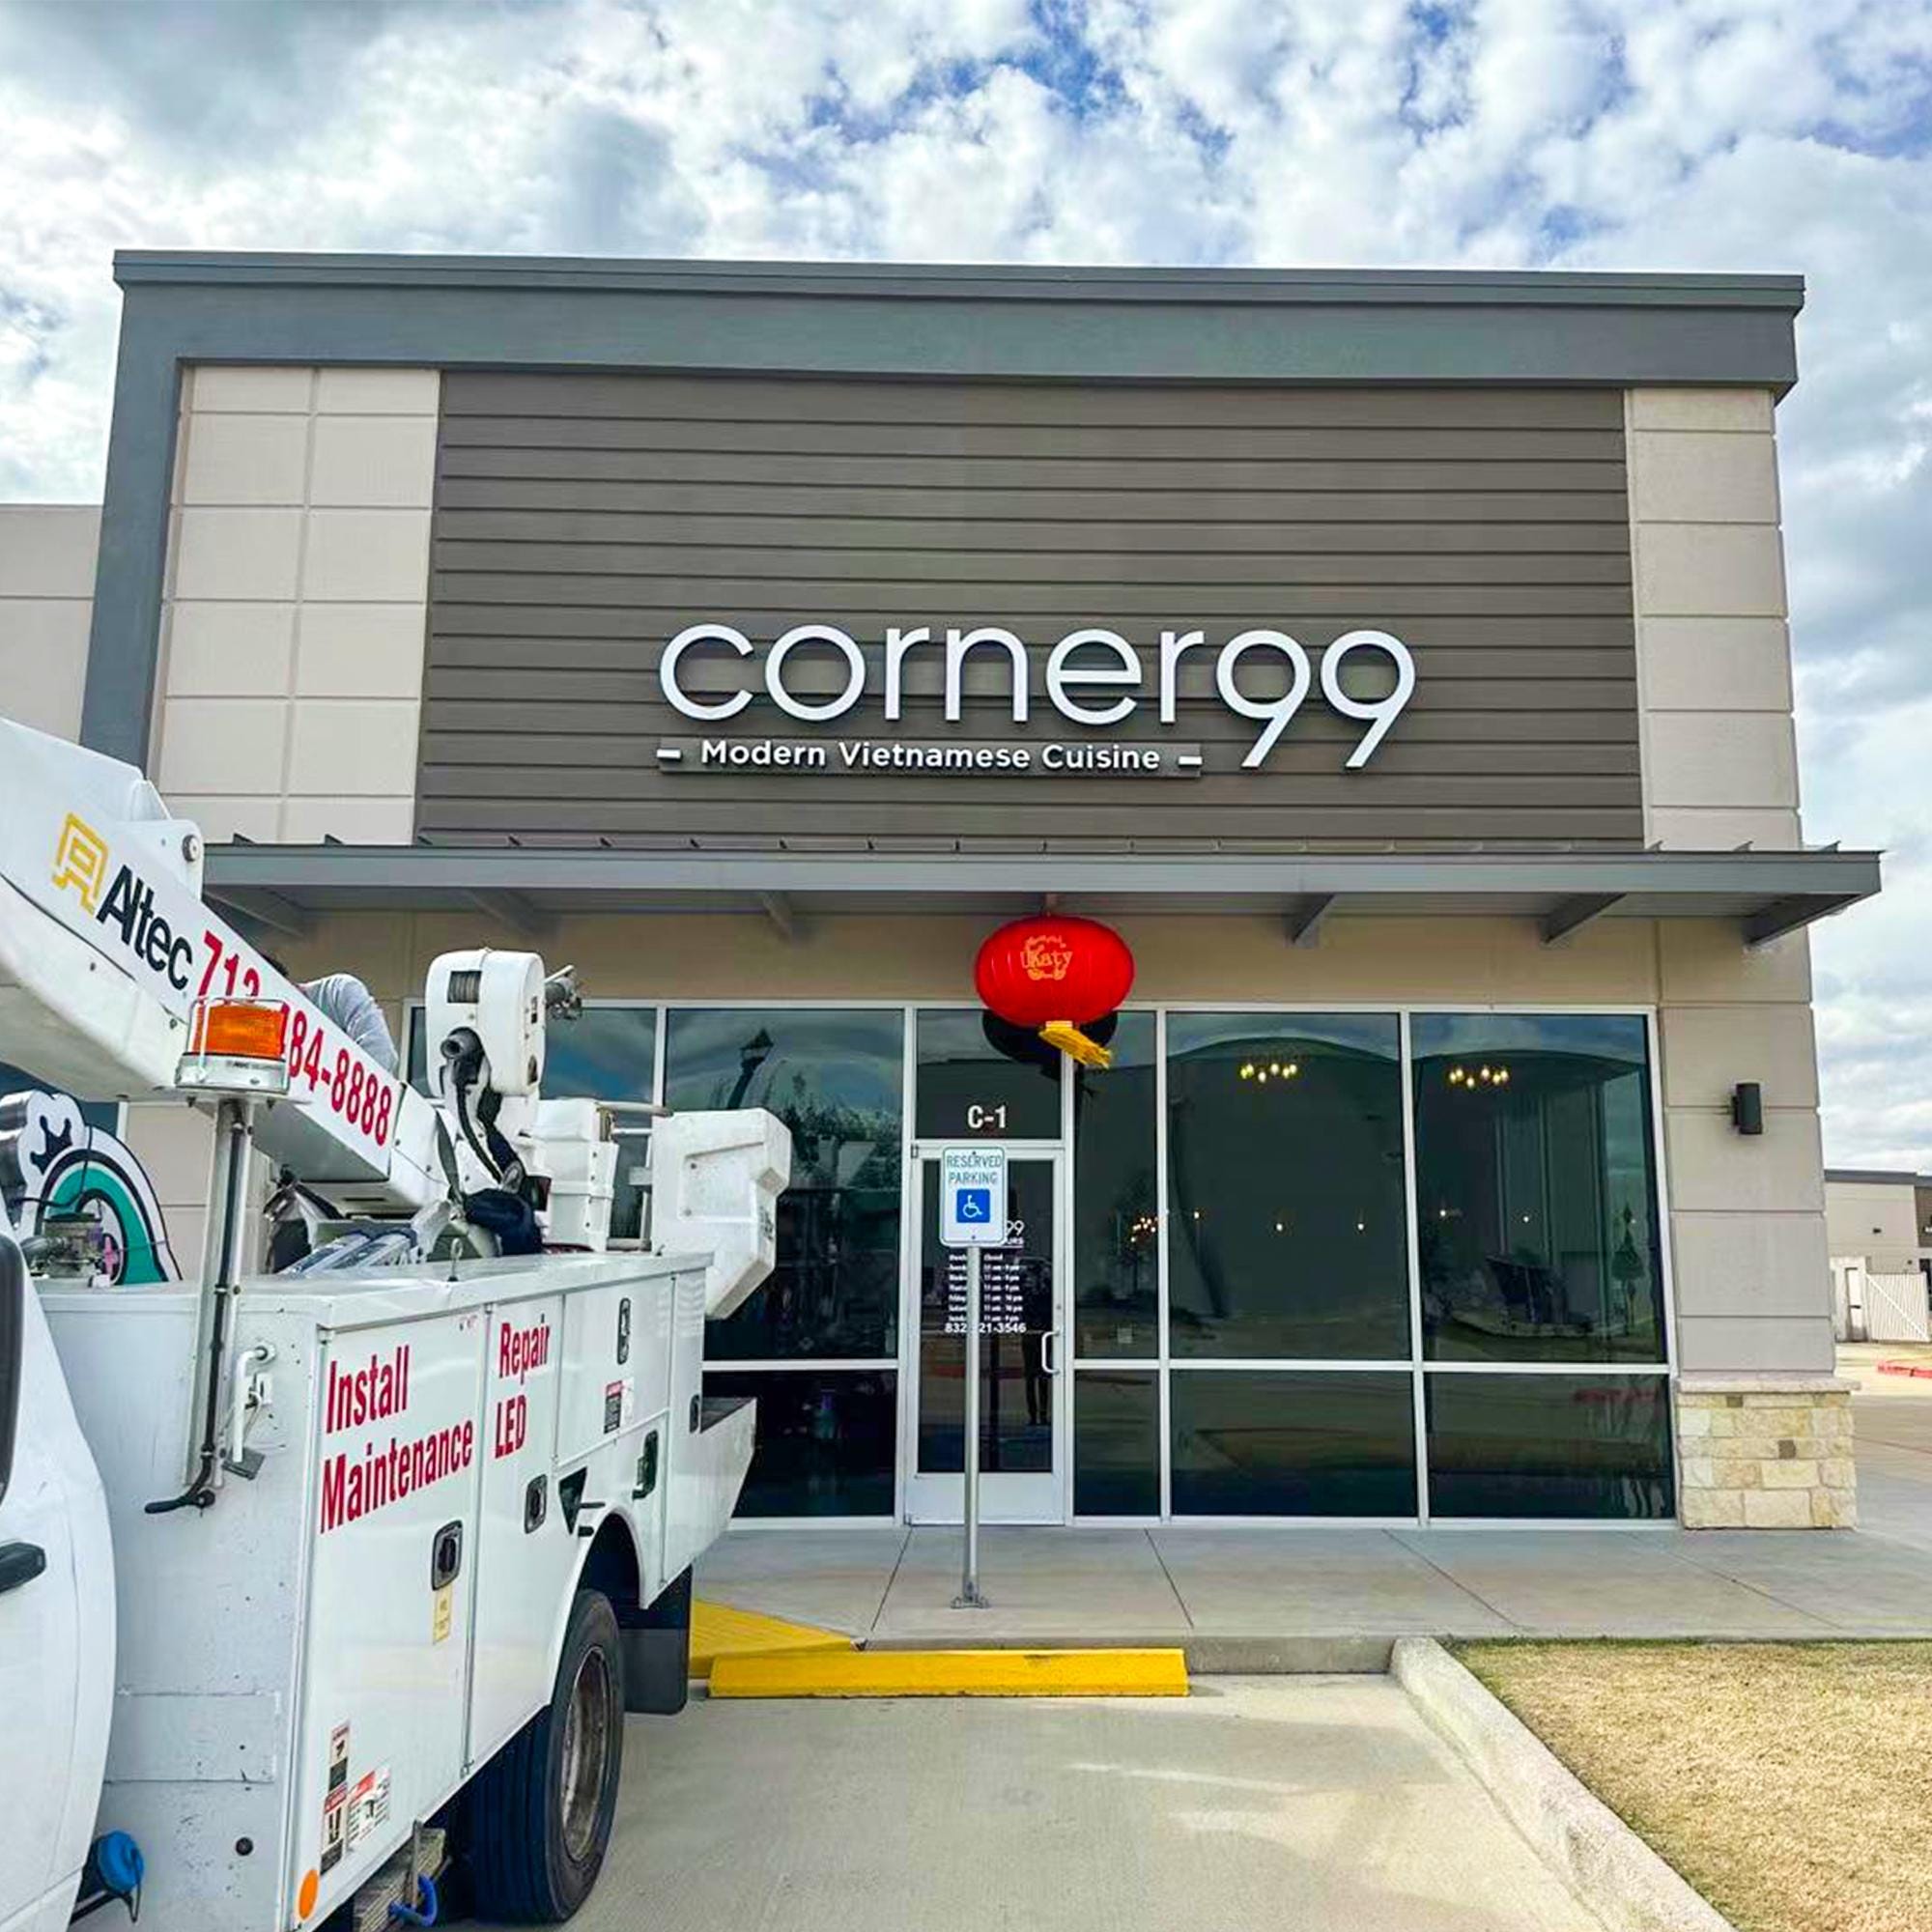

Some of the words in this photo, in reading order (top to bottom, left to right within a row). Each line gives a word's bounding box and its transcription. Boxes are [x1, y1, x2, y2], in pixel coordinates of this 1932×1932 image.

[660, 624, 1415, 767] corner99
[701, 739, 826, 767] Modern
[838, 741, 1031, 769] Vietnamese
[1041, 743, 1160, 771] Cuisine
[97, 864, 193, 990] Altec
[967, 1105, 1006, 1128] C-1
[947, 1154, 1002, 1168] RESERVED
[948, 1171, 998, 1185] PARKING
[498, 1314, 551, 1384] Repair
[326, 1345, 410, 1435] Install
[494, 1394, 527, 1459] LED
[320, 1420, 473, 1534] Maintenance
